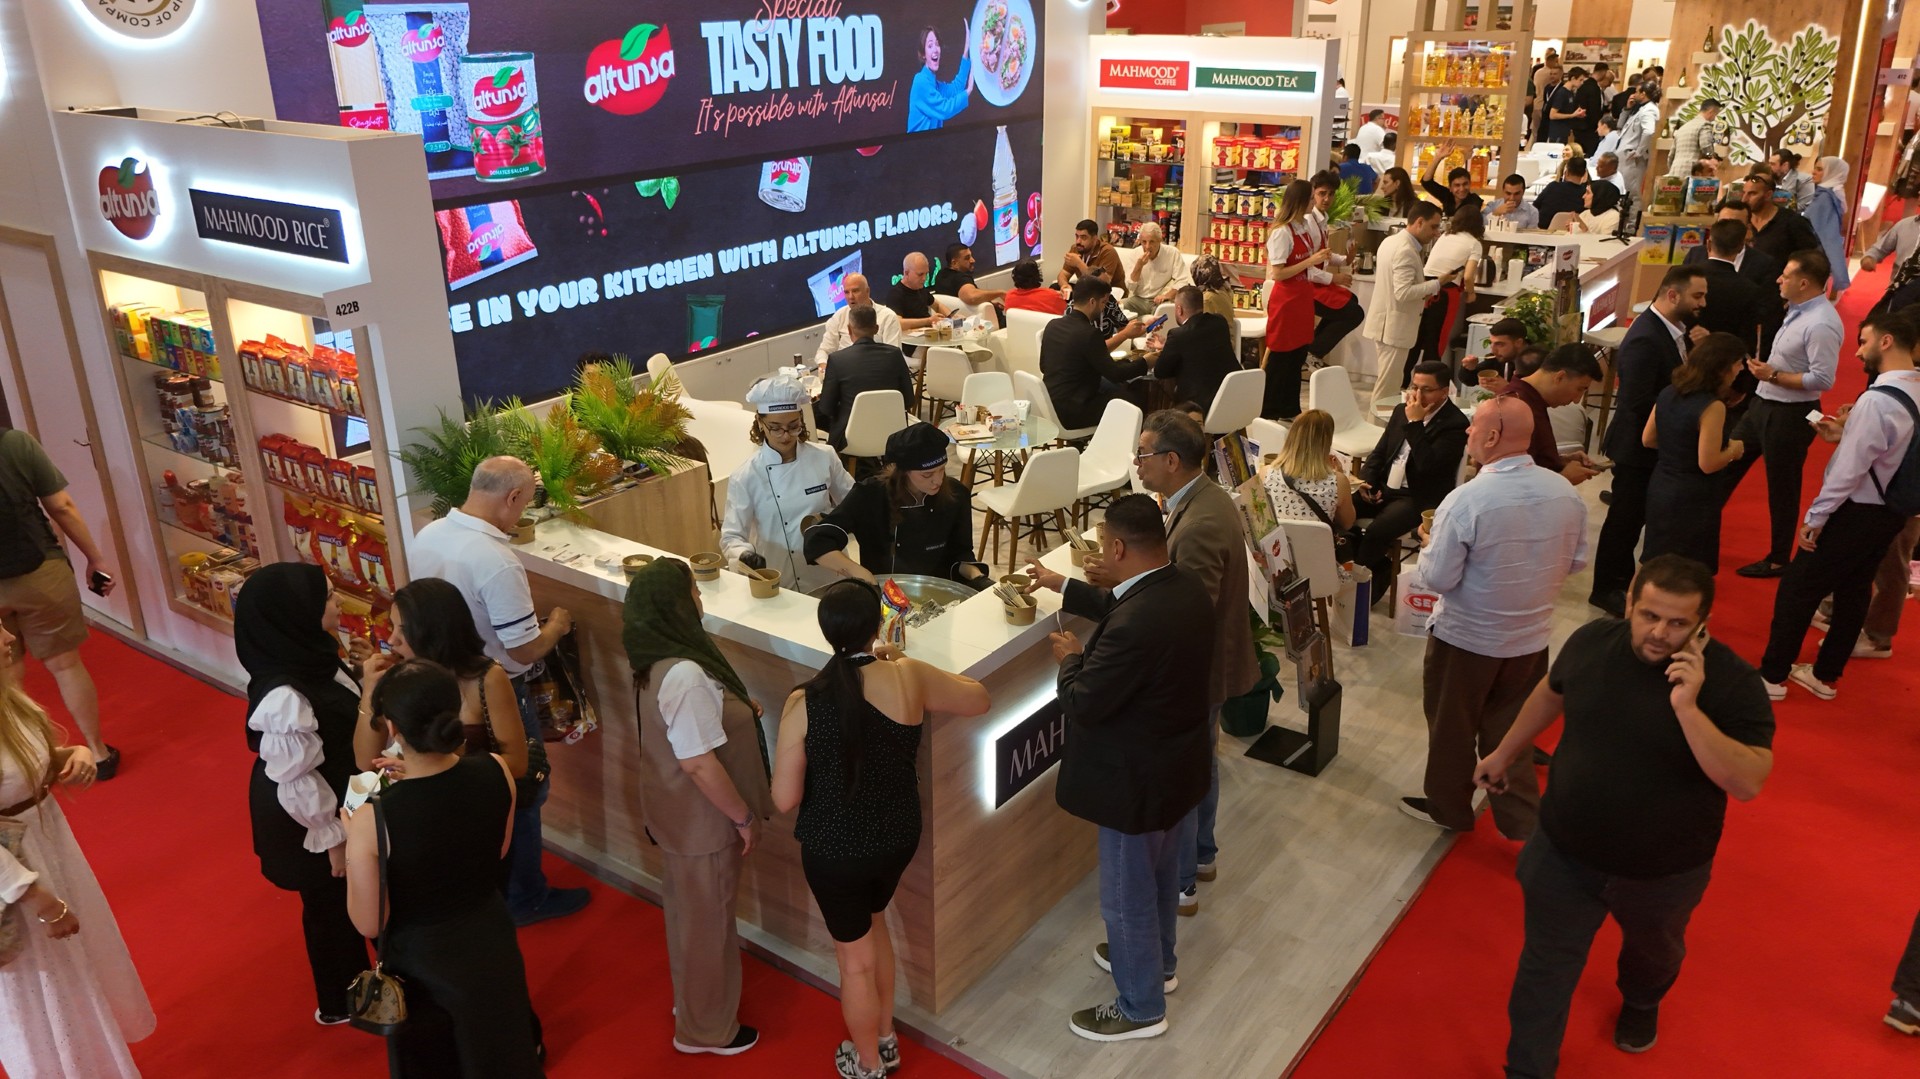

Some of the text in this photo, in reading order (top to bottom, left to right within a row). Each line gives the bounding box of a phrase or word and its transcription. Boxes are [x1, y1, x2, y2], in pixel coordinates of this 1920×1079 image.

[156, 11, 171, 26] OF
[755, 0, 842, 38] Special
[401, 33, 446, 57] altunsa
[700, 14, 884, 95] TASTY FOOD
[584, 50, 675, 104] altunsa
[1154, 78, 1177, 87] COFFEE
[1212, 72, 1274, 87] MAHMOOD
[474, 81, 527, 111] altunsa
[725, 93, 795, 138] possible
[798, 88, 828, 119] with
[831, 80, 898, 124] Altunsa!
[100, 188, 161, 221] altunsa
[203, 206, 289, 242] MAHMOOD
[449, 202, 958, 333] E IN YOUR KITCHEN WITH ALTUNSA FLAVORS.
[335, 301, 360, 317] 422B
[1010, 713, 1065, 785] MAH
